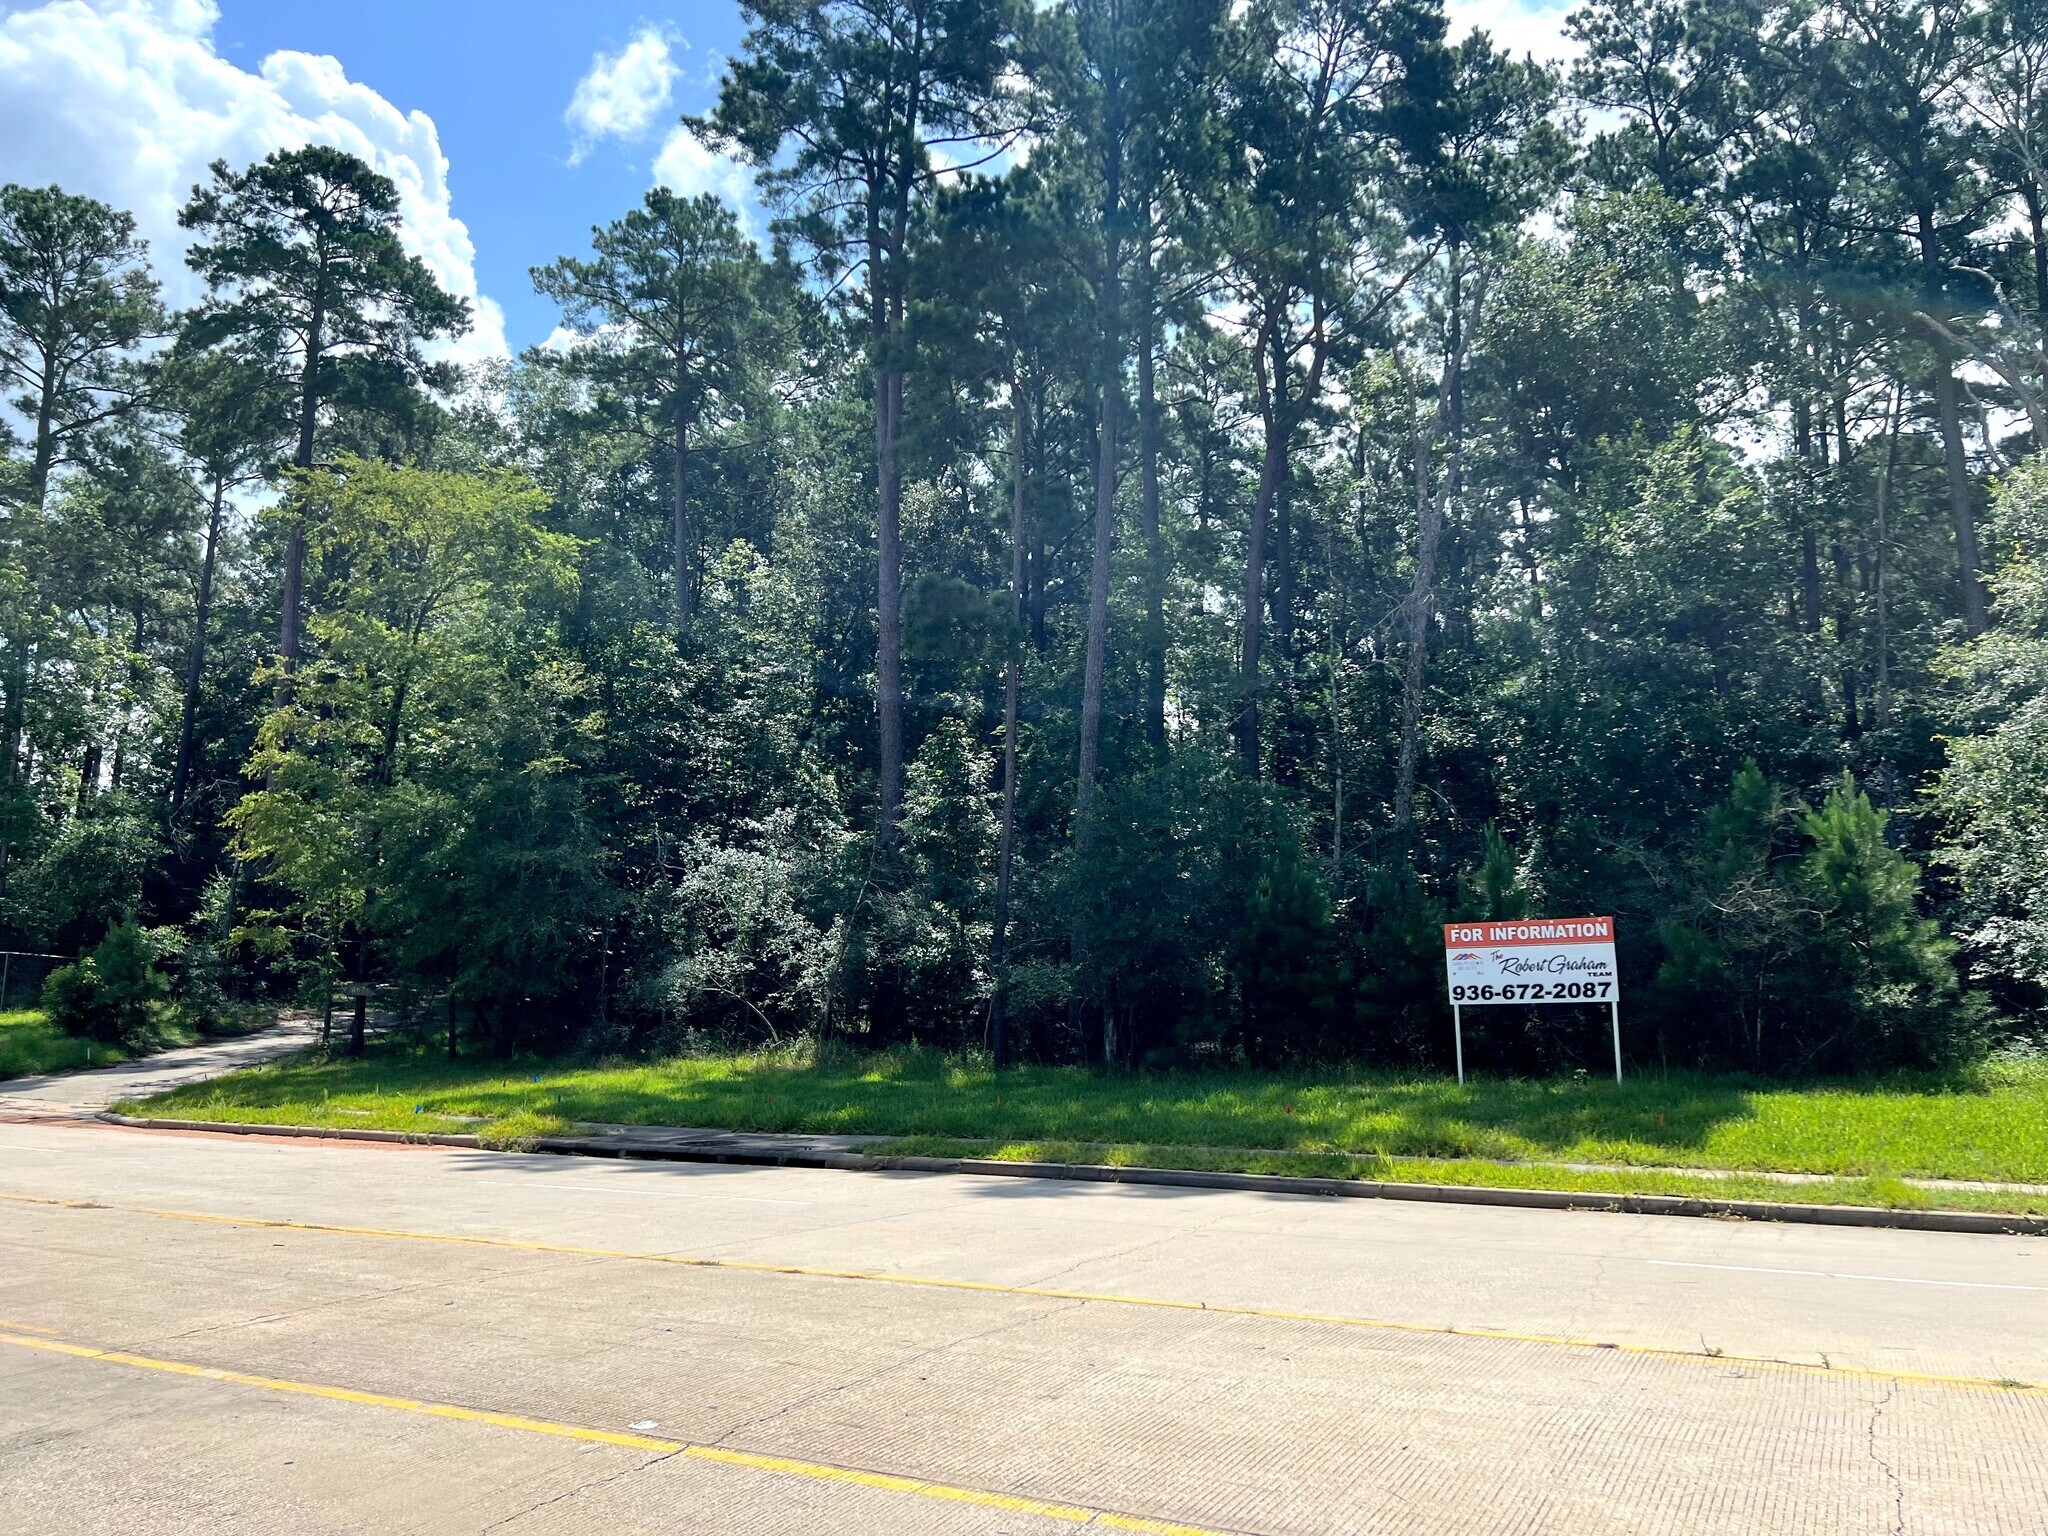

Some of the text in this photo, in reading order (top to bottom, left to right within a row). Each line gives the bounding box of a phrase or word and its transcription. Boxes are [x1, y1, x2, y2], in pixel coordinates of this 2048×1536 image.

[1450, 922, 1609, 943] FOR INFORMATION
[1490, 949, 1609, 977] The Robert Graham
[1452, 982, 1612, 1001] 936-672-2087
